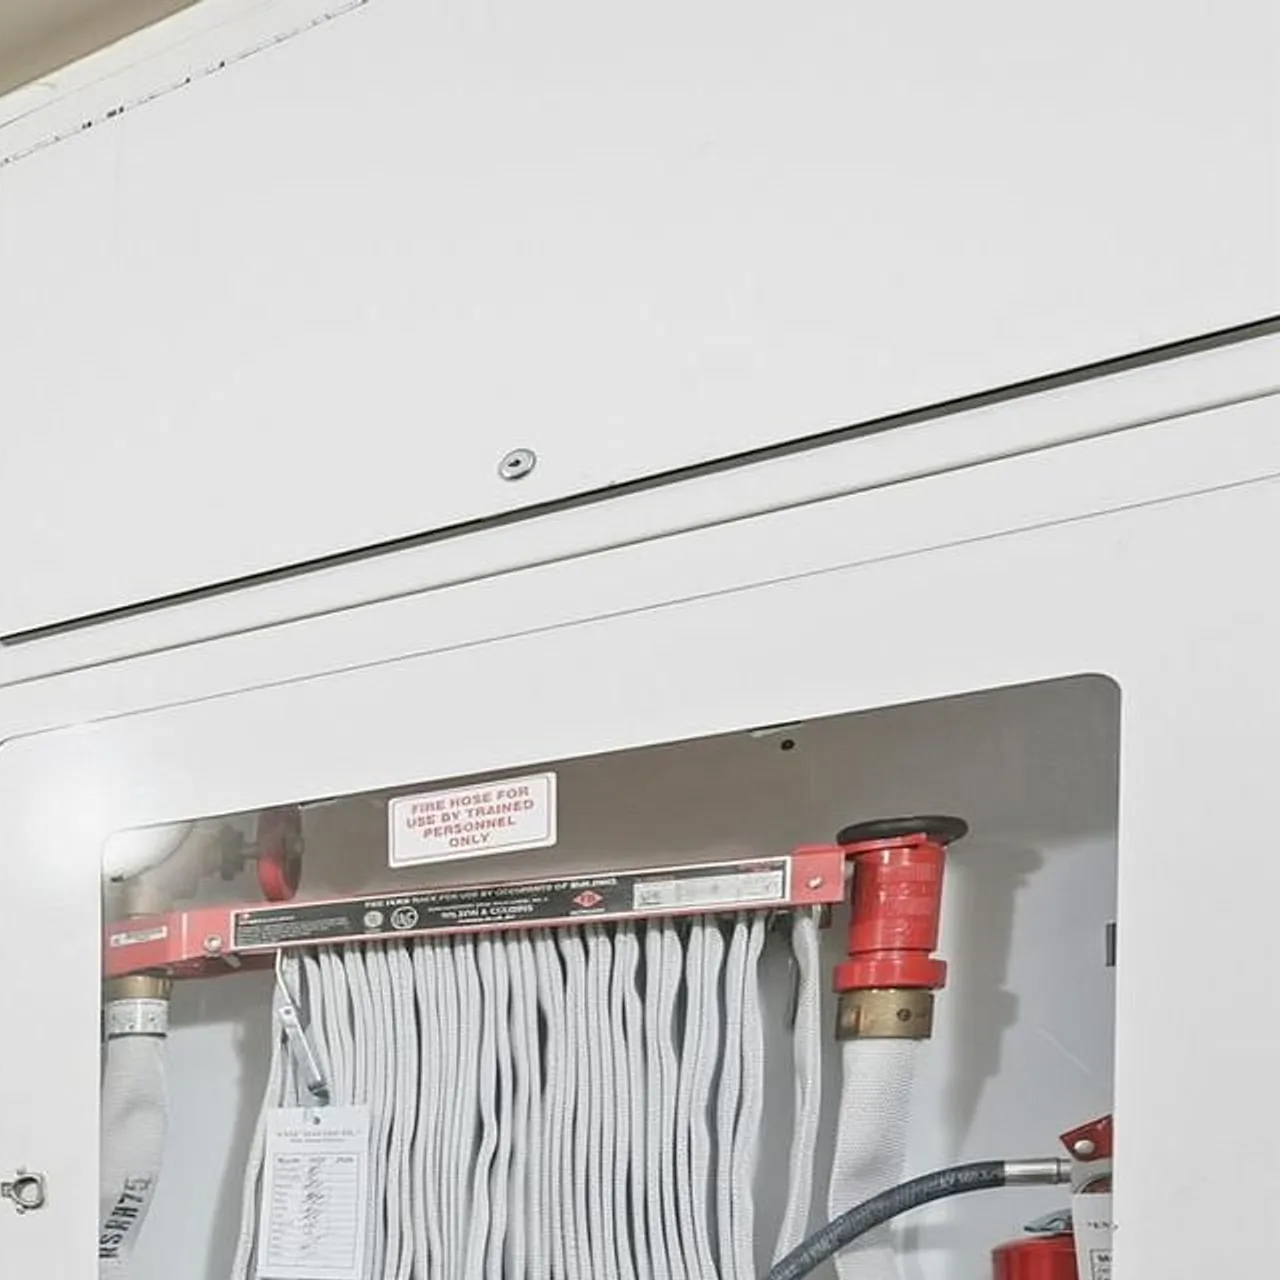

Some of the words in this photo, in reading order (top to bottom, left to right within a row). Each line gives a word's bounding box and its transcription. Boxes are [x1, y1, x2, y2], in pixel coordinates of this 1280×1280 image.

[411, 801, 446, 815] FIRE
[450, 792, 493, 808] HOSE
[496, 786, 530, 800] FOR
[406, 813, 437, 829] USE
[441, 810, 461, 823] BY
[466, 799, 535, 819] TRAINED
[422, 816, 517, 838] PERSONNEL
[448, 832, 491, 848] ONLY
